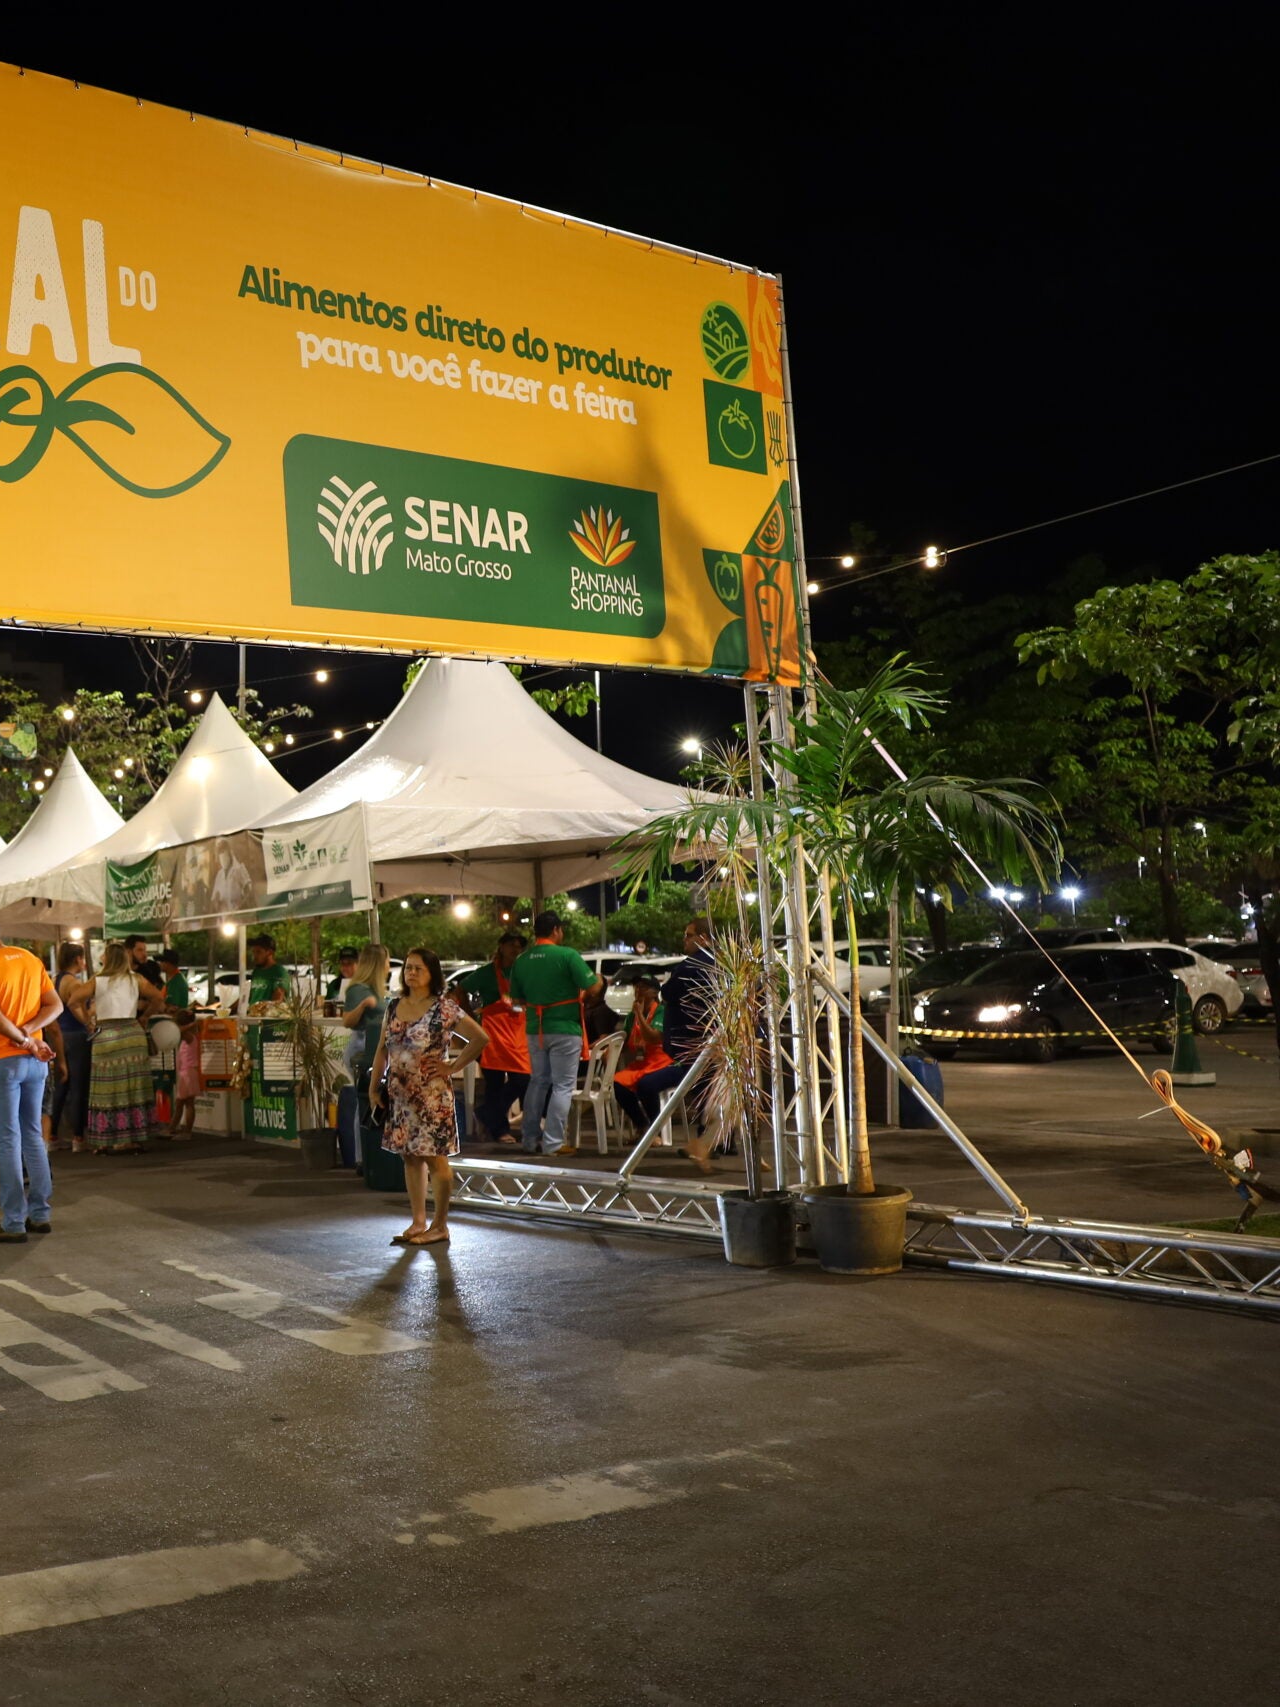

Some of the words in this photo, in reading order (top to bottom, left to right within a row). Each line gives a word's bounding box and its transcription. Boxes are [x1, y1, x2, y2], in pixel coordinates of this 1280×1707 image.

[119, 266, 157, 312] DO
[237, 264, 408, 332] Alimentos
[415, 305, 505, 354] direto
[512, 327, 549, 363] do
[554, 342, 673, 391] produtor
[296, 331, 382, 374] para
[387, 347, 463, 389] você
[467, 359, 543, 405] fazer
[548, 386, 570, 412] a
[573, 382, 638, 425] feira
[404, 496, 532, 554] SENAR
[406, 547, 452, 575] Mato
[455, 554, 512, 581] Grosso
[570, 566, 641, 597] PANTANAL
[570, 587, 644, 618] SHOPPING
[253, 1108, 268, 1128] PRA
